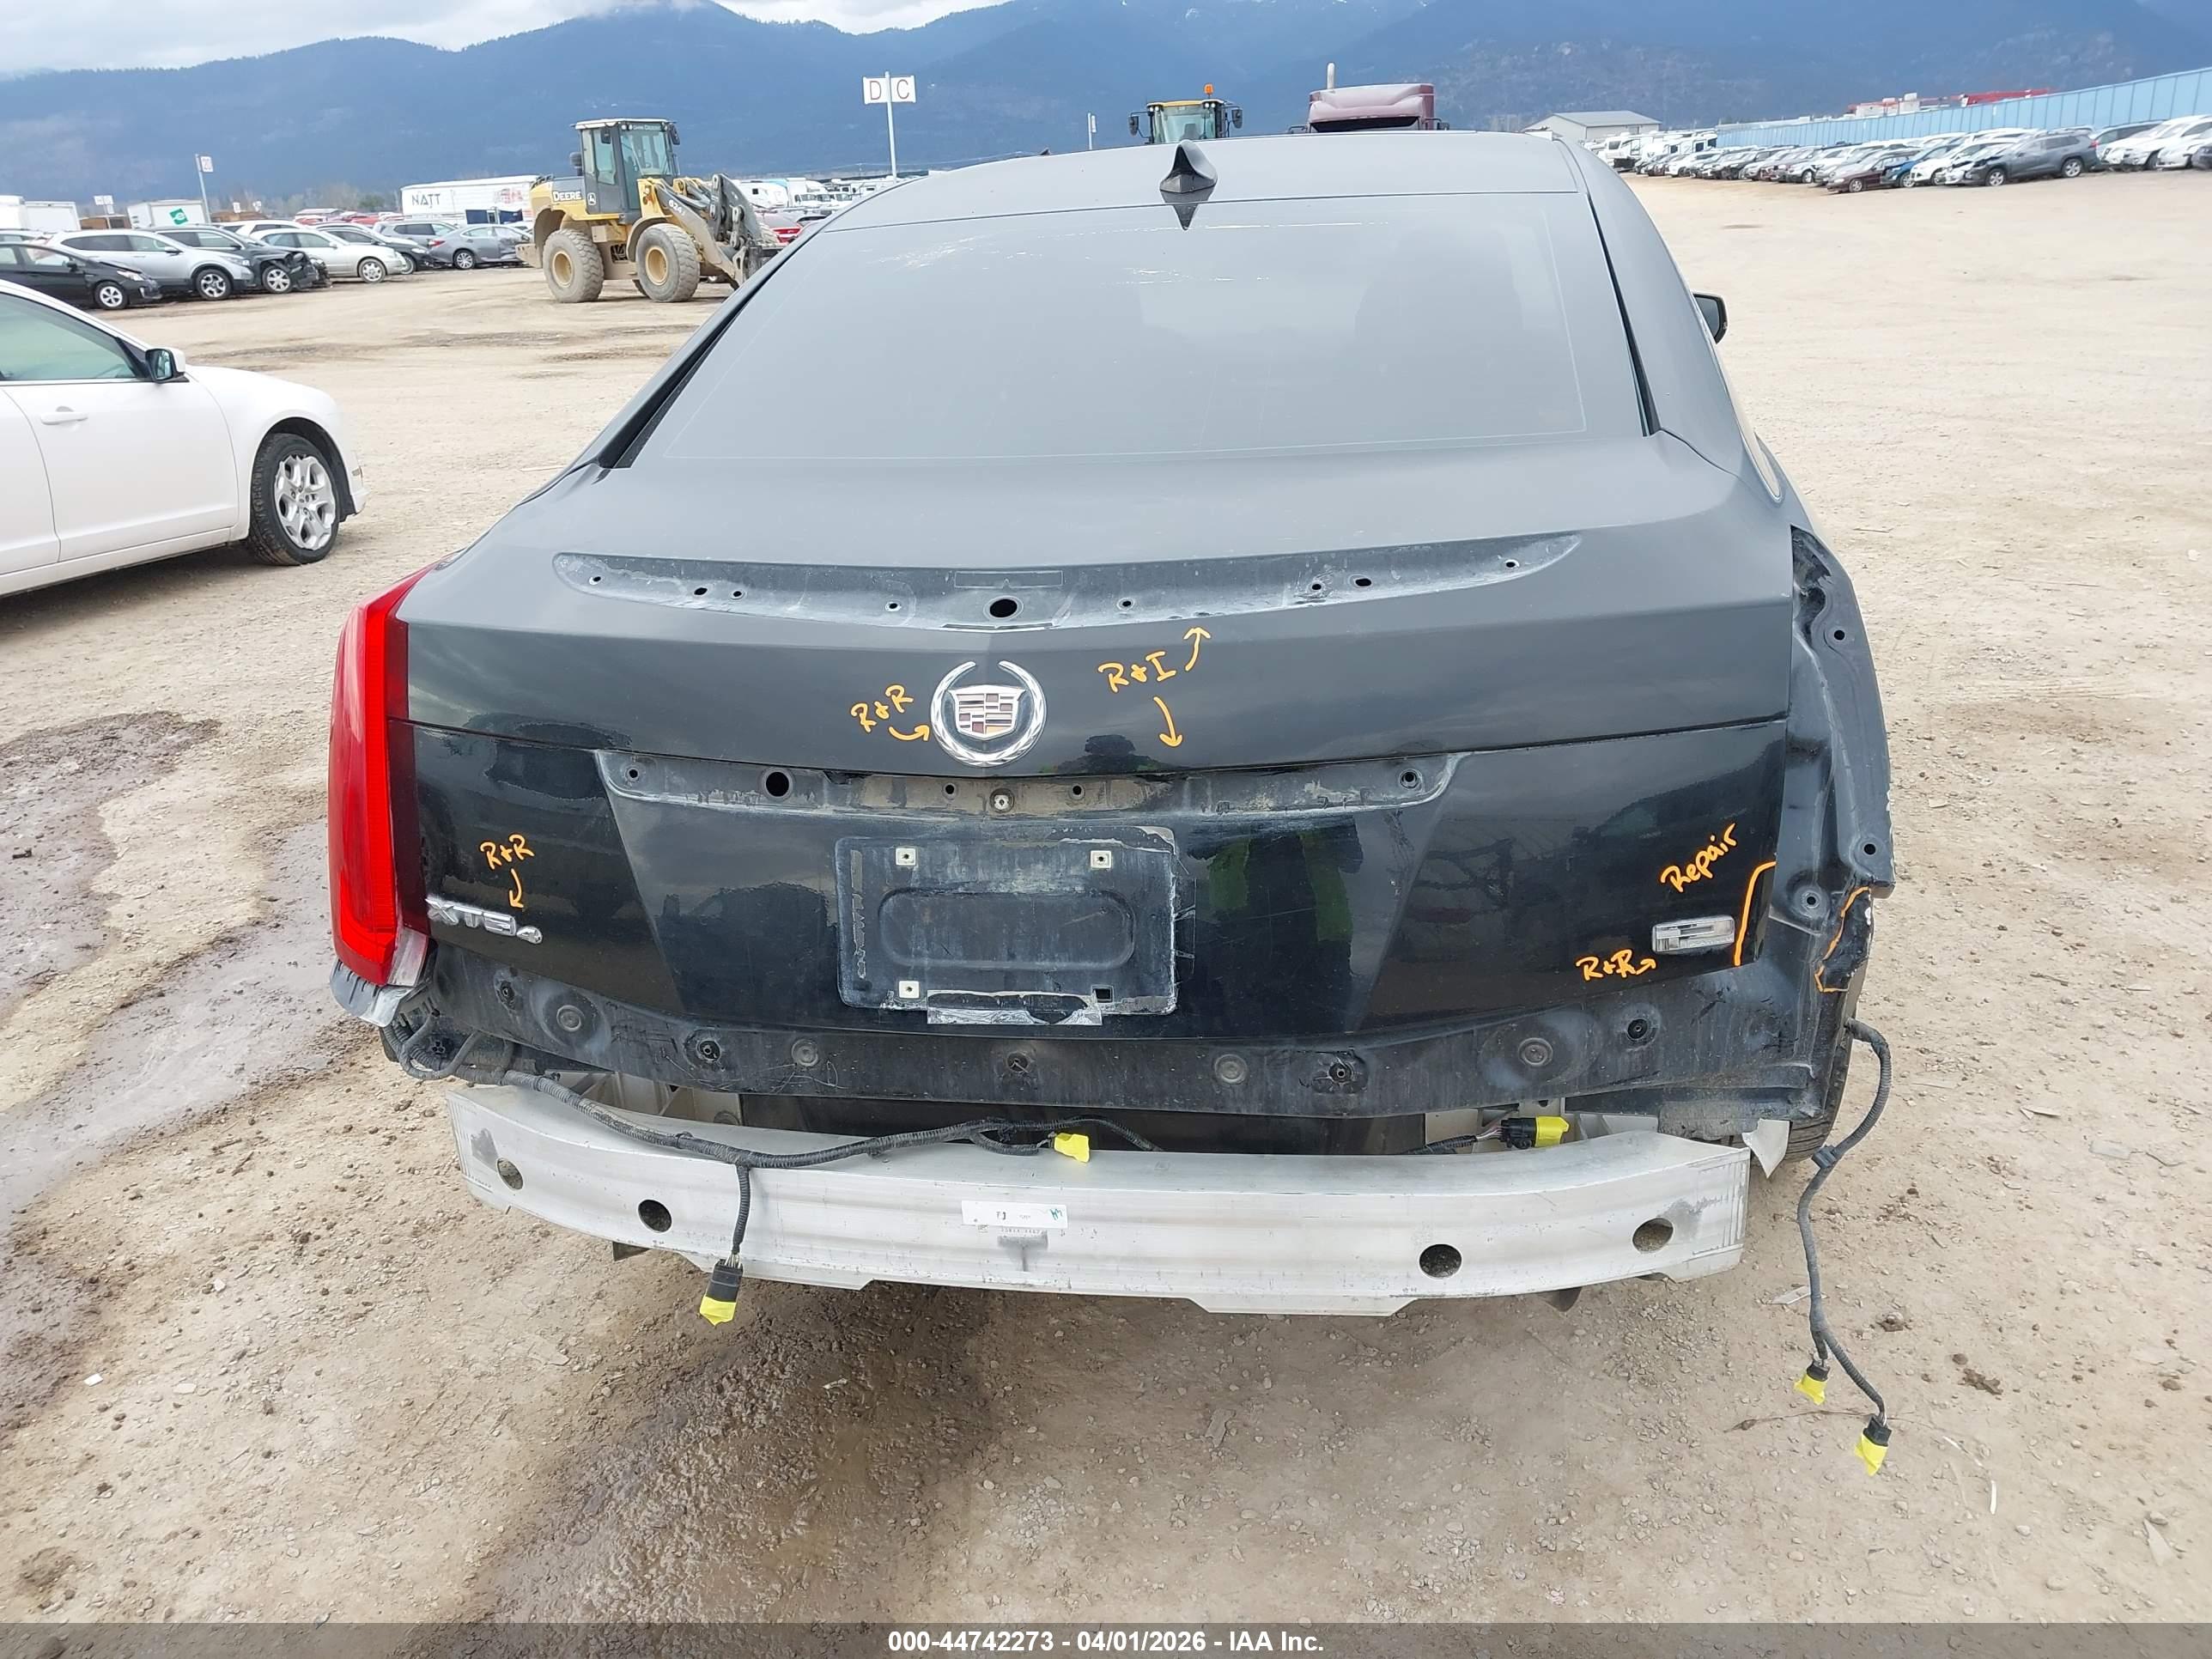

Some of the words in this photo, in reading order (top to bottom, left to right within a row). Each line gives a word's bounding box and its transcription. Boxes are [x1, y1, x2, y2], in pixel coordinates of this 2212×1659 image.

[869, 80, 882, 100] D
[896, 79, 910, 100] C
[552, 191, 582, 202] DEERE
[1660, 822, 1737, 893] Repair
